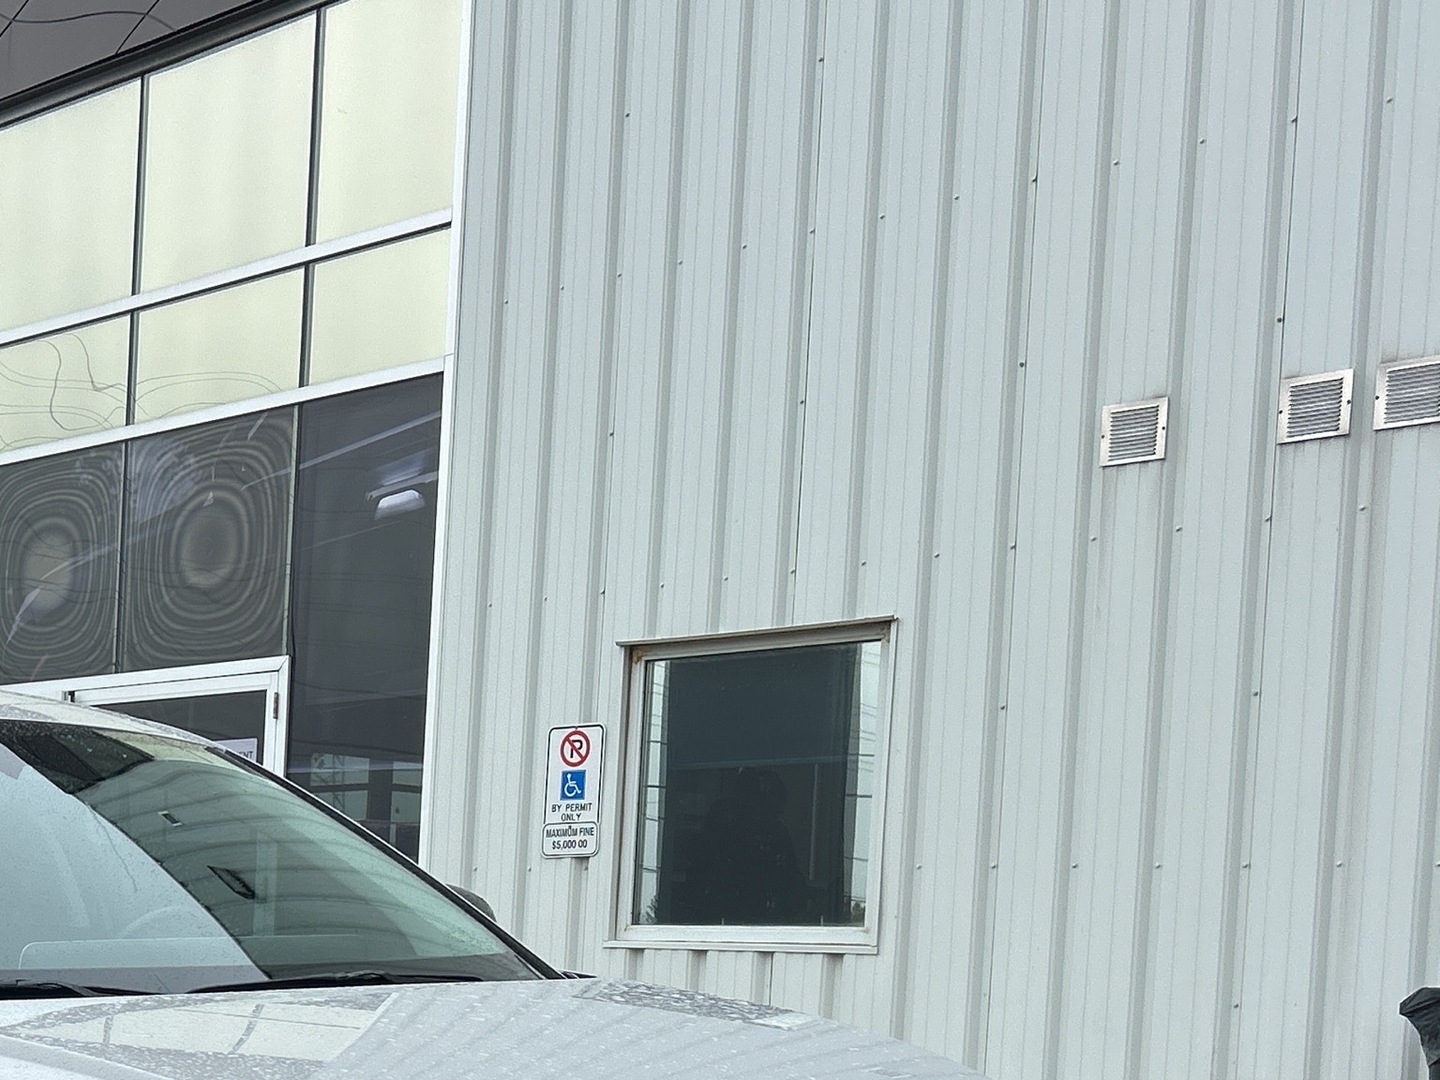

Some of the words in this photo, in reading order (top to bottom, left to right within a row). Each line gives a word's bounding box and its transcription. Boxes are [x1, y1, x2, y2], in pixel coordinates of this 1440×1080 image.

[551, 803, 562, 813] BY
[565, 802, 592, 812] PERMIT
[560, 812, 582, 822] ONLY
[545, 826, 578, 838] MAXIMUM
[579, 826, 595, 837] FINE
